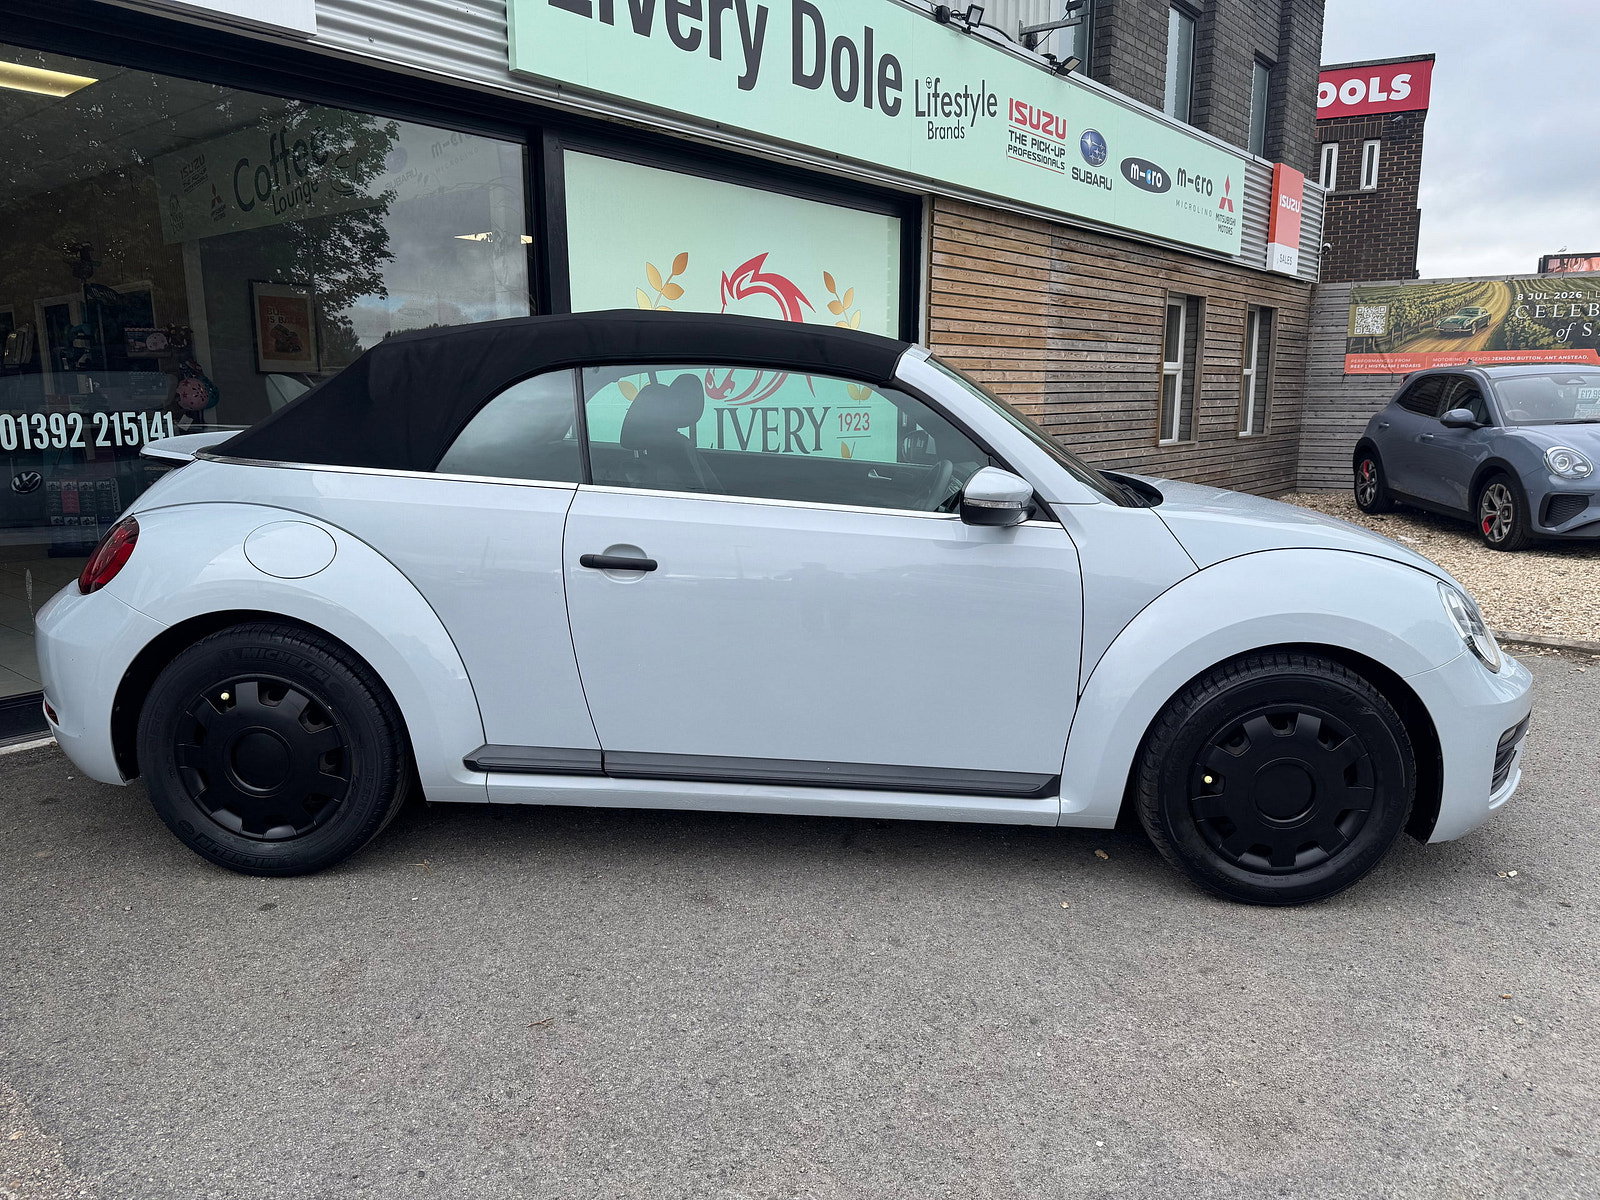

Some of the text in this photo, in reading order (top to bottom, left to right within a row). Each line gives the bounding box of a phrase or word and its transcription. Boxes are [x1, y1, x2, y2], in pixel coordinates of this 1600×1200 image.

[548, 0, 902, 117] very Dole
[915, 77, 998, 127] Lifestyle
[927, 119, 965, 140] Brands
[1009, 98, 1067, 140] ISUZU
[1009, 130, 1066, 158] THE PICK-UP
[180, 154, 205, 179] ISUZU
[234, 126, 328, 212] Coffee
[1007, 144, 1066, 170] PROFESSIONALS
[1071, 167, 1113, 191] SUBARU
[272, 179, 319, 216] Lounge
[1175, 199, 1213, 218] MICROLINO
[1279, 194, 1301, 213] ISUZU
[1215, 213, 1236, 226] MITSUBISHI
[1217, 223, 1233, 236] MOTORS
[1279, 253, 1293, 266] SALES
[1517, 291, 1583, 301] 8 JUL 2026
[1515, 302, 1600, 319] CELEB
[1556, 322, 1600, 343] of S
[0, 411, 175, 451] 01392 215141
[838, 412, 871, 432] 1923
[240, 647, 331, 682] MICHELIN
